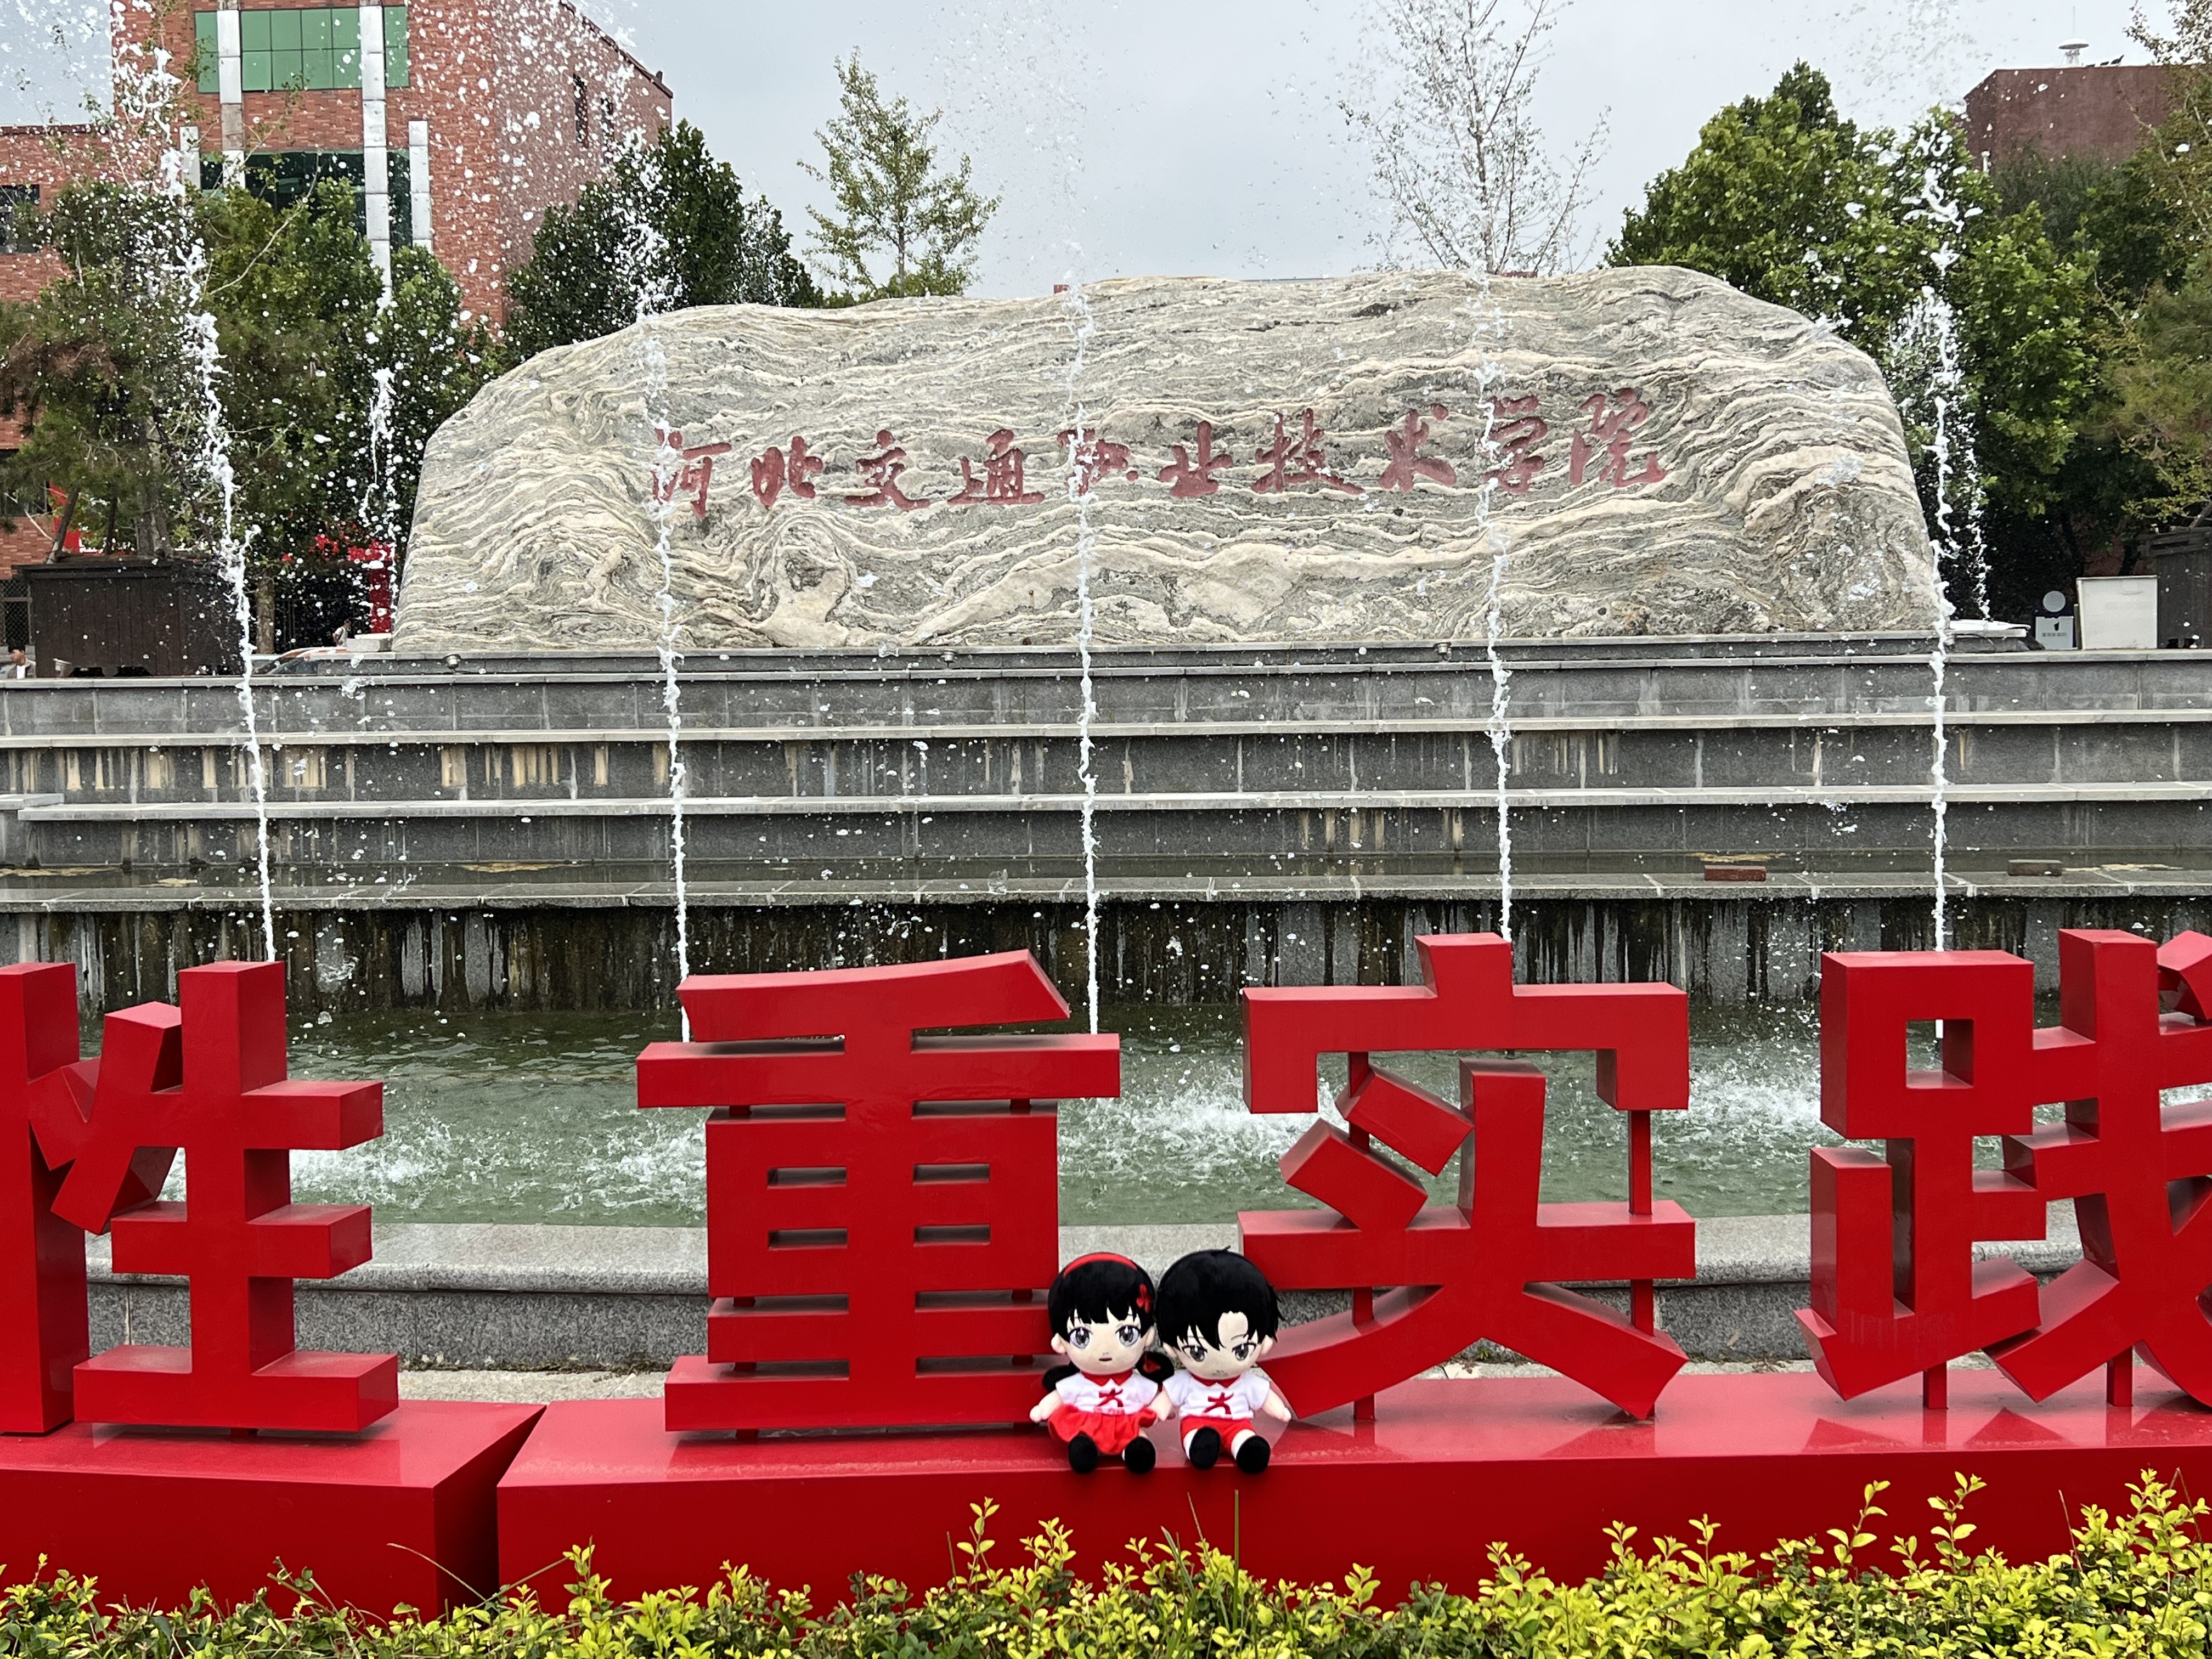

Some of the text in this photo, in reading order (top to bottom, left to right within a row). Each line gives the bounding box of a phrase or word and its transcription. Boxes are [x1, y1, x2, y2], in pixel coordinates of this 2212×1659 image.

[651, 387, 1668, 517] 河北交通职业技术学院
